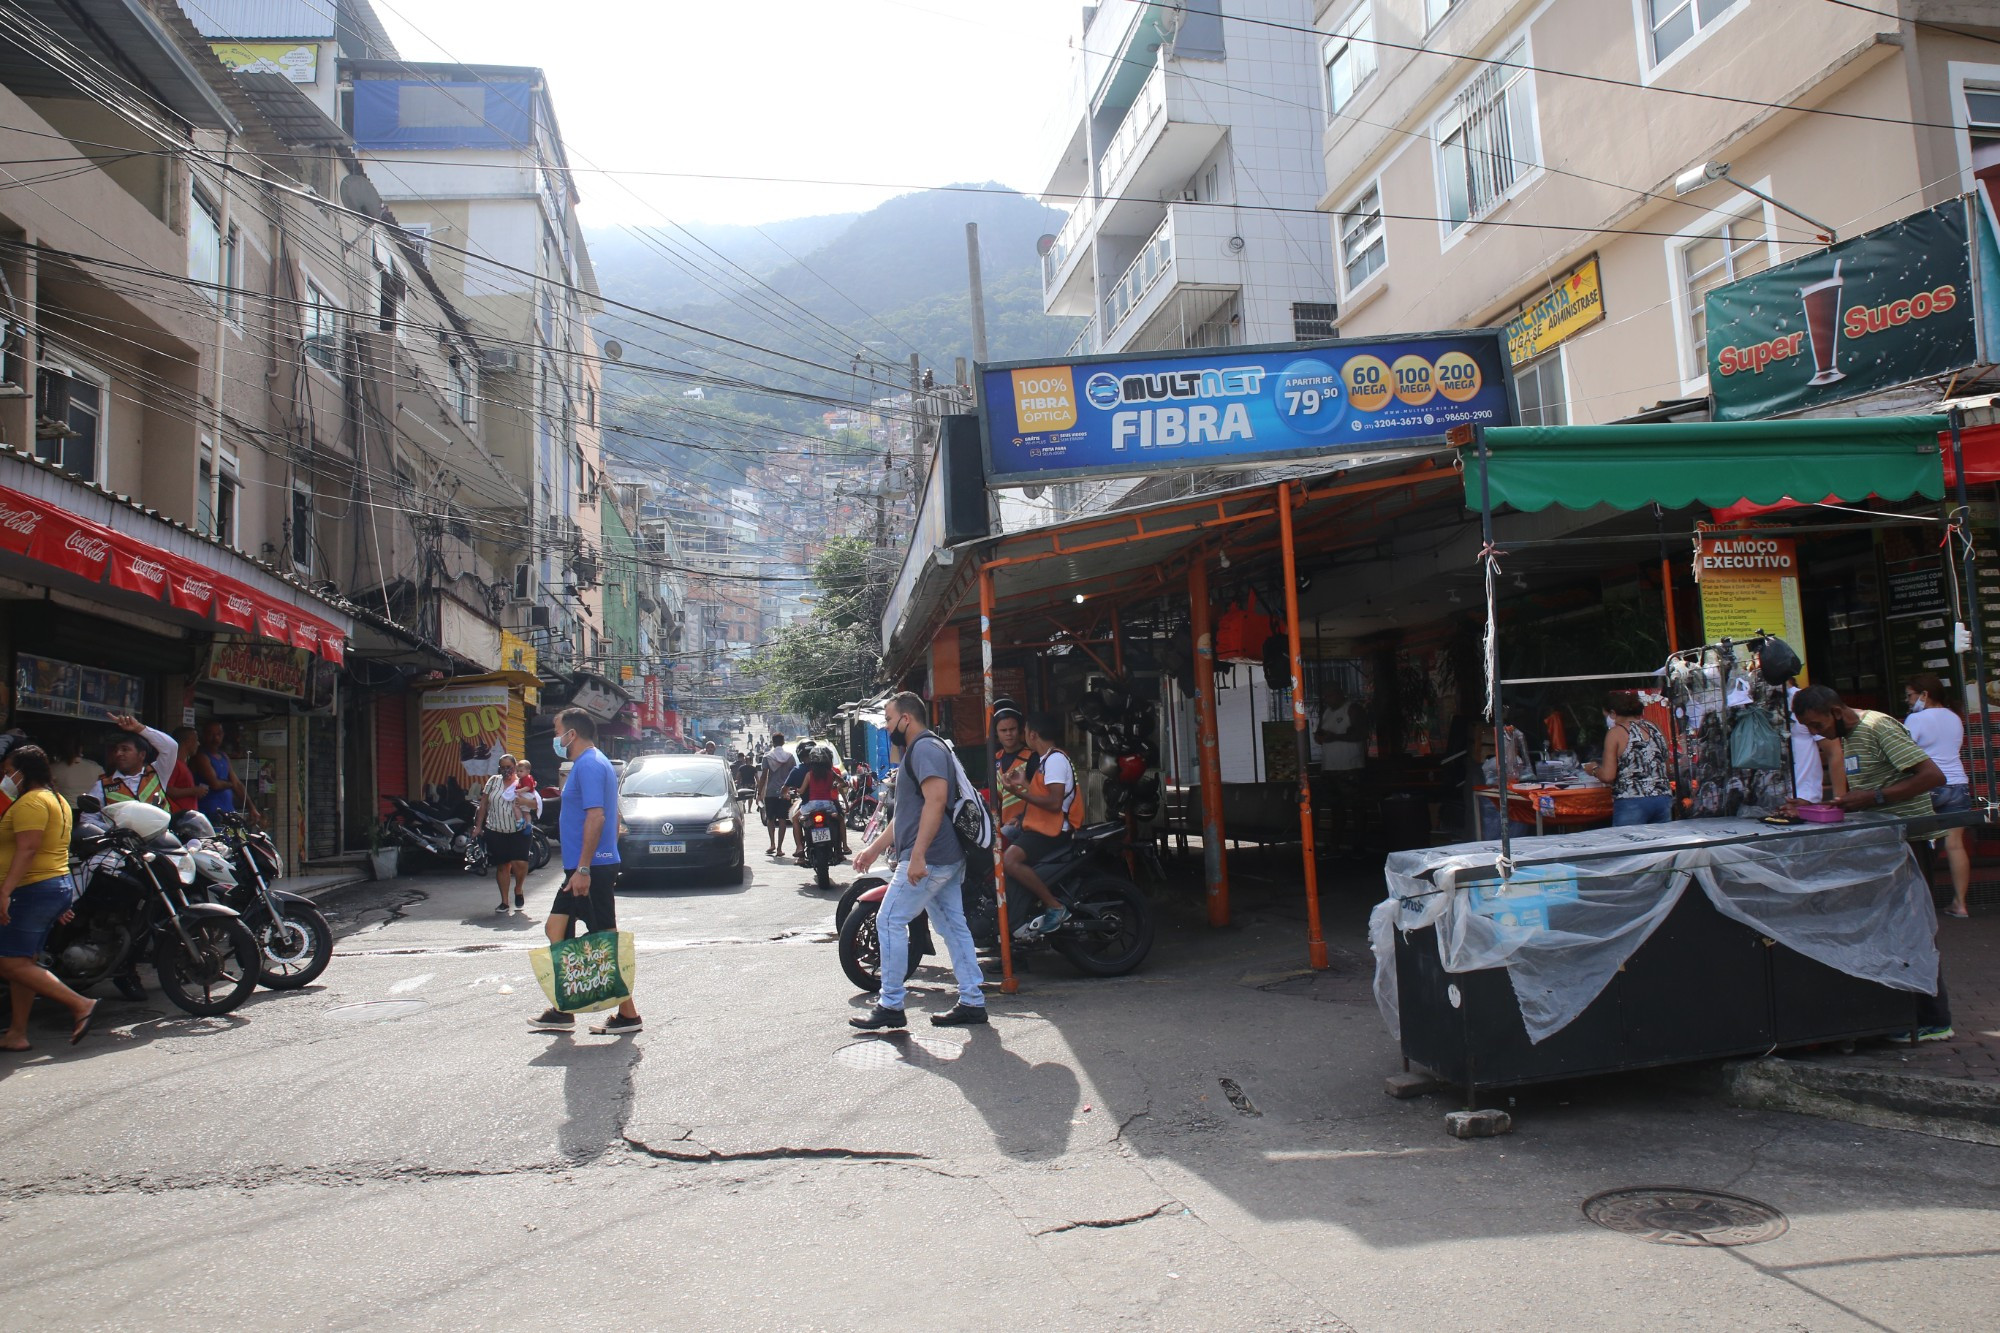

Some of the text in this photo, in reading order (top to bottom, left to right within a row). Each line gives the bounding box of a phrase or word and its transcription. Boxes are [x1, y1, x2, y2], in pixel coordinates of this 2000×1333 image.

[1718, 284, 1956, 375] Super Sucos
[1285, 375, 1333, 387] A PARTIR DE
[1353, 363, 1475, 385] 60 100 200
[1019, 378, 1067, 394] 100%
[1121, 366, 1265, 403] MULTNET
[1351, 379, 1476, 397] MEGA MEGA MEGA
[1021, 396, 1070, 411] FIBRA
[1023, 410, 1071, 423] ÓPTICA
[1374, 416, 1423, 428] 3204-3673
[1444, 409, 1493, 422] 98650-2900
[1111, 402, 1255, 450] FIBRA
[1713, 541, 1778, 556] ALMOÇO
[1703, 555, 1791, 569] EXECUTIVO
[219, 647, 252, 675] SABOR
[252, 656, 271, 680] DAS
[271, 662, 301, 688] FRUTAS
[434, 705, 501, 745] 1,00
[567, 949, 609, 966] Eu não
[599, 961, 616, 972] da
[562, 972, 614, 996] moda
